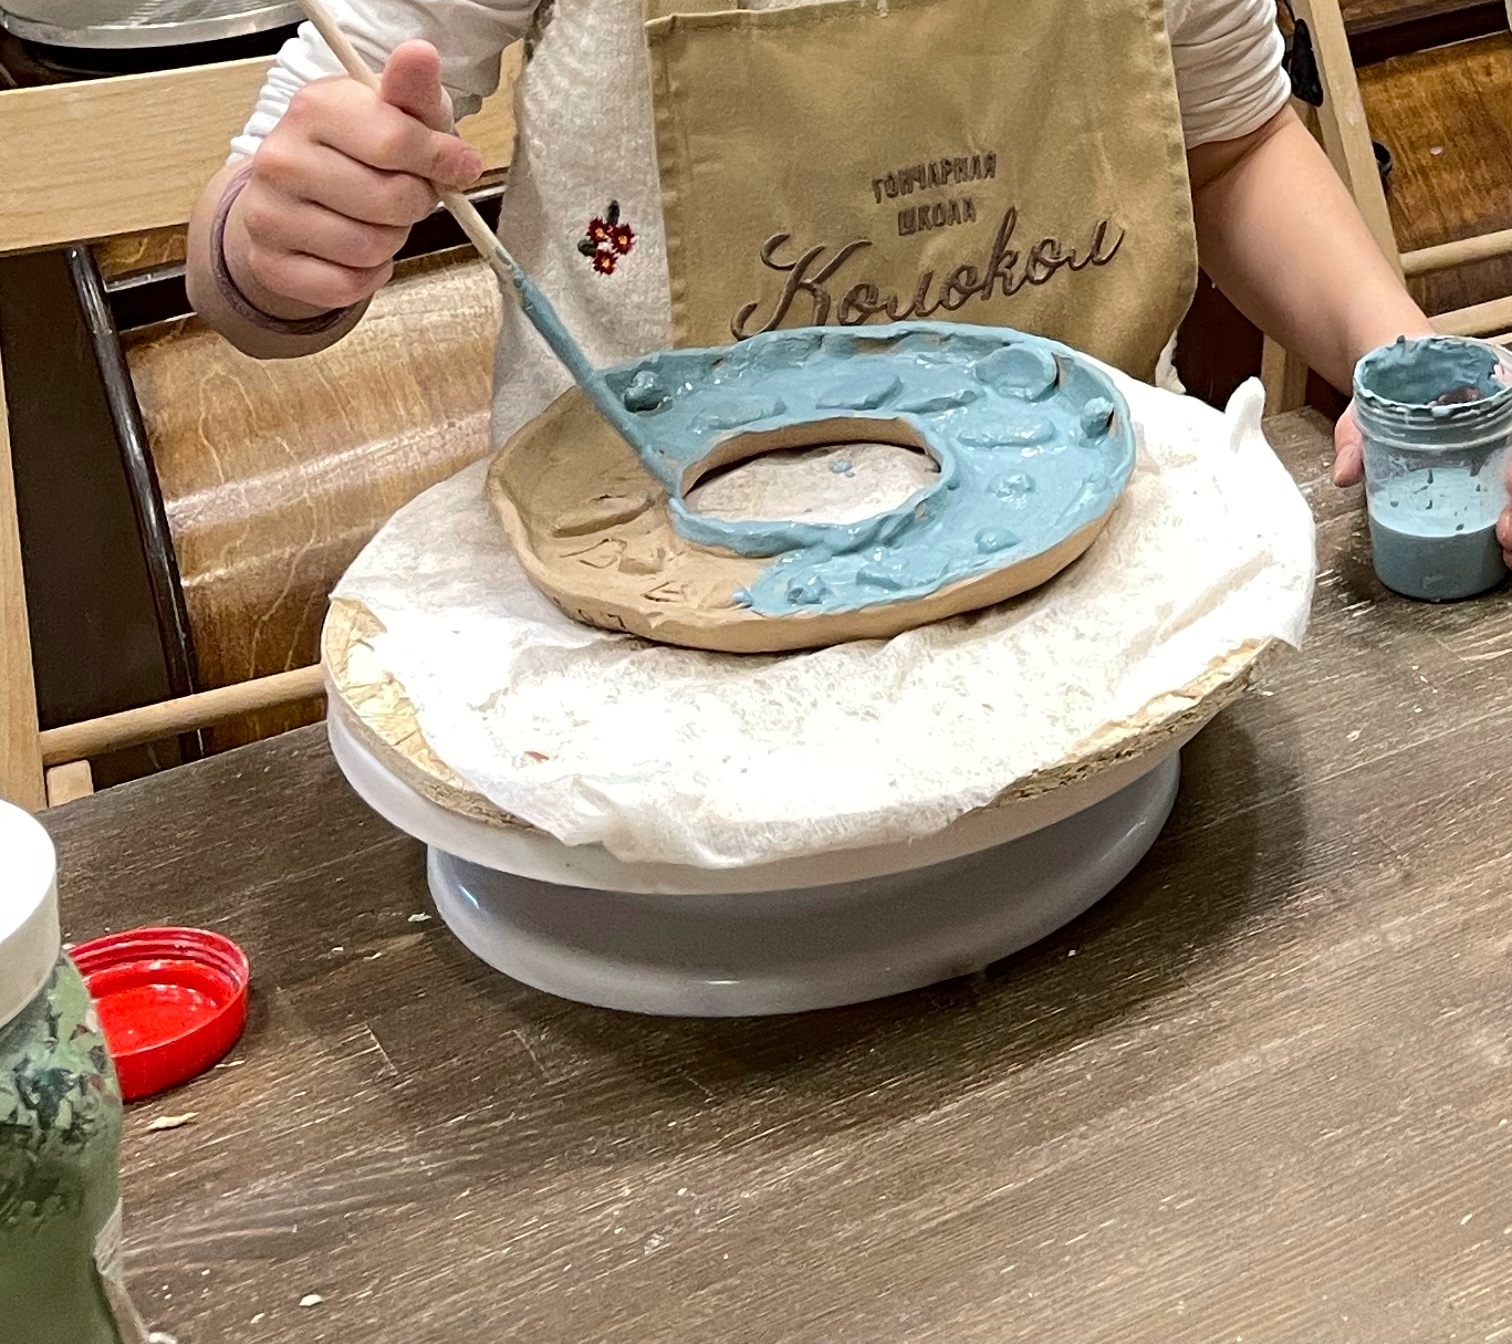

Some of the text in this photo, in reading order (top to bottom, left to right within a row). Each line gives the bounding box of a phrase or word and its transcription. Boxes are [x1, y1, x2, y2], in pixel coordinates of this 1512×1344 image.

[871, 151, 998, 204] ГОНЧАРНАЯ
[897, 197, 978, 237] ШКОЛА
[729, 205, 1126, 341] Колокол
